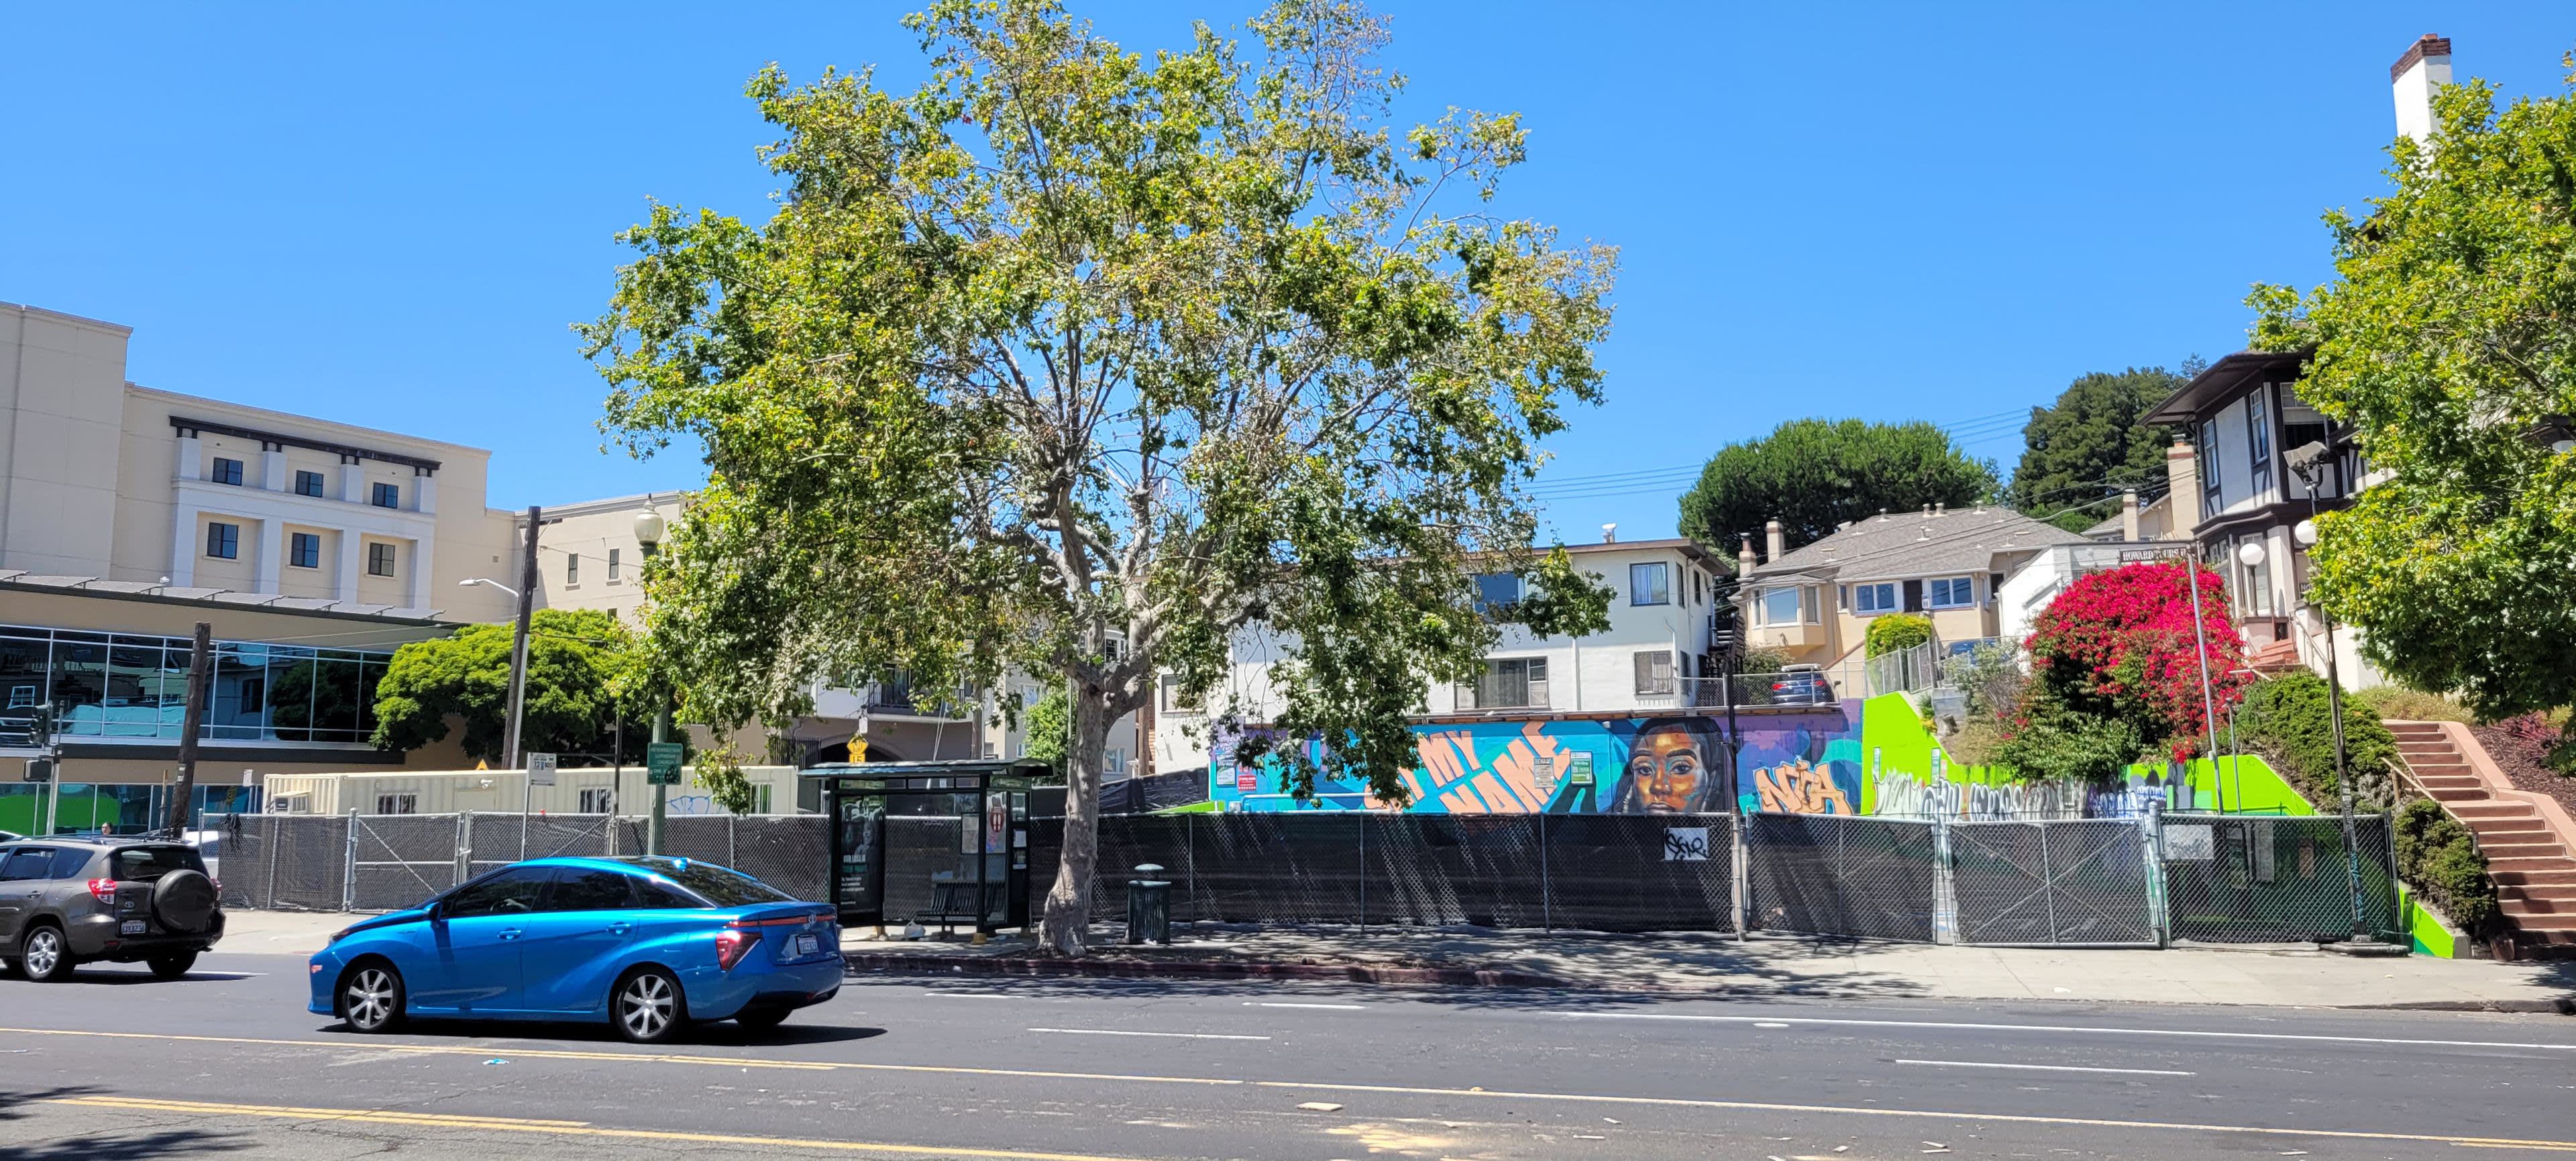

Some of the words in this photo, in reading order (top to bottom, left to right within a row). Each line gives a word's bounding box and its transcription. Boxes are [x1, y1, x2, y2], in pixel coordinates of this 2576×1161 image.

[2123, 550, 2153, 561] HOWARD
[1417, 730, 1481, 789] MY
[1438, 721, 1572, 813] NAME
